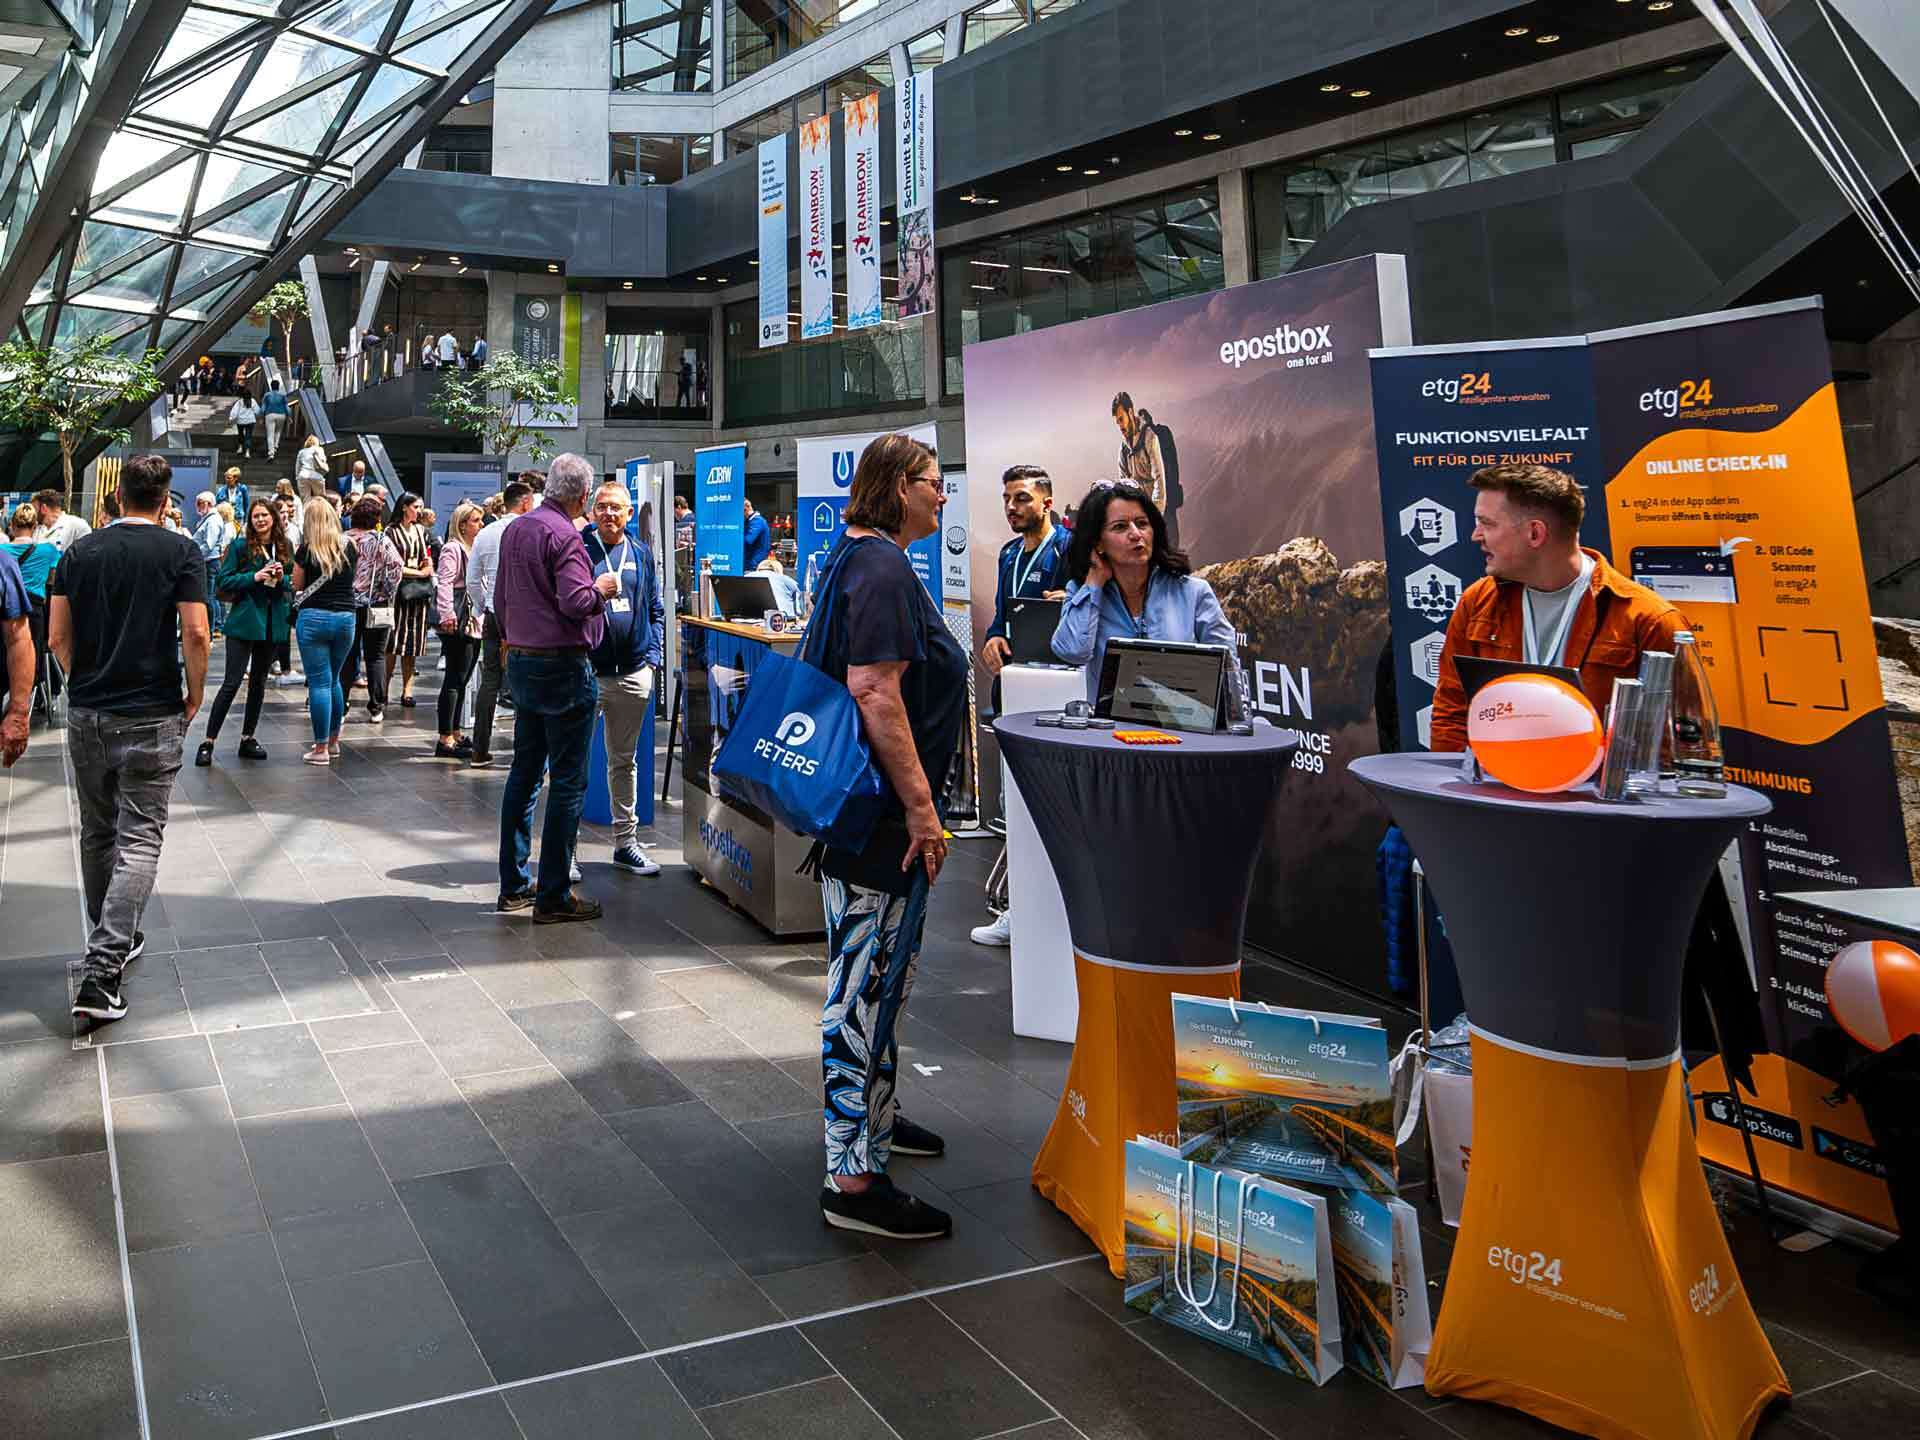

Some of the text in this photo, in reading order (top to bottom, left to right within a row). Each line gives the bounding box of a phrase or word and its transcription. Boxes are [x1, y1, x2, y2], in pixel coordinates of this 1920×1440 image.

[902, 79, 912, 208] Schmitt & Scalzo
[855, 152, 867, 232] RAINBOW
[809, 170, 820, 246] RAINBOW
[1220, 324, 1333, 368] epostbox
[1286, 352, 1333, 369] one for all
[1421, 373, 1492, 403] etg24
[1639, 379, 1713, 417] etg24
[1395, 427, 1589, 445] FUNKTIONSVIELFALT
[1413, 452, 1573, 466] FIT FÜR DIE ZUKUNFT
[1646, 454, 1788, 475] ONLINE CHECK-IN
[1755, 545, 1814, 556] 2. QR Code
[1771, 562, 1817, 572] Scanner
[1479, 702, 1513, 722] etg24
[753, 738, 819, 777] PETERS
[1748, 821, 1809, 842] 1. Aktuellen
[1765, 840, 1840, 866] Abstimmungs-
[1768, 858, 1858, 885] punkt auswählen
[1758, 889, 1770, 902] 2.
[1776, 911, 1803, 926] durch
[1804, 918, 1823, 932] den
[1823, 922, 1847, 937] Ver-
[1780, 943, 1816, 965] Stimme
[1769, 976, 1782, 989] 3.
[1785, 981, 1802, 994] Auf
[1787, 998, 1823, 1019] klicken
[1212, 1034, 1255, 1049] ZUKUNFT
[1308, 1042, 1347, 1058] etg24
[1241, 1049, 1299, 1066] wunderbar
[1760, 1121, 1794, 1143] Store
[1487, 1245, 1563, 1286] etg24
[1689, 1263, 1720, 1316] etg24
